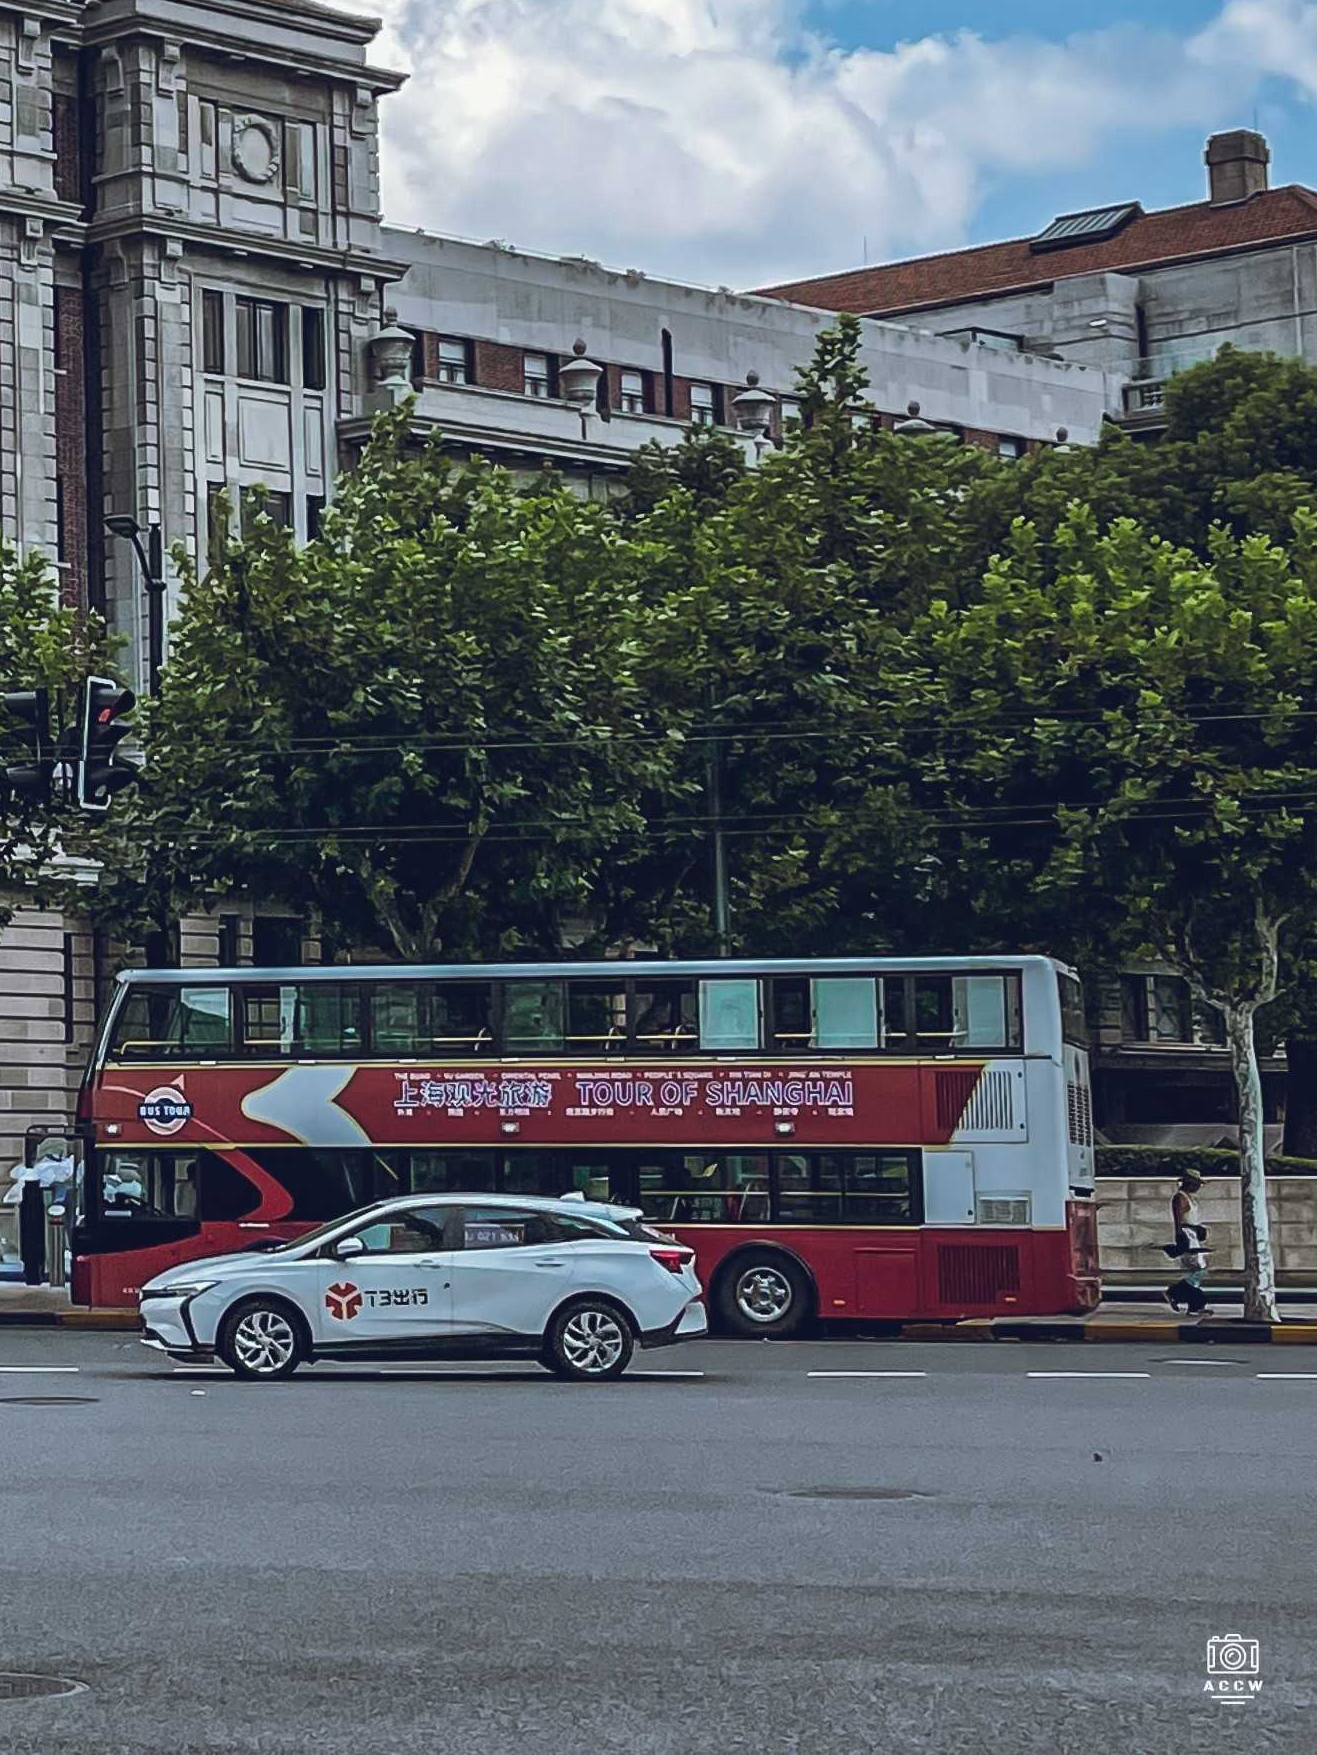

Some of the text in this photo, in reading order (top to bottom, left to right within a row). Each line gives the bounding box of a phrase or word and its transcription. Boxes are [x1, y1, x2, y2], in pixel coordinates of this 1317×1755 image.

[393, 1080, 553, 1108] 上海观光旅游
[575, 1081, 853, 1106] TOUR OF SHANGHAI
[363, 1288, 429, 1308] T3出行
